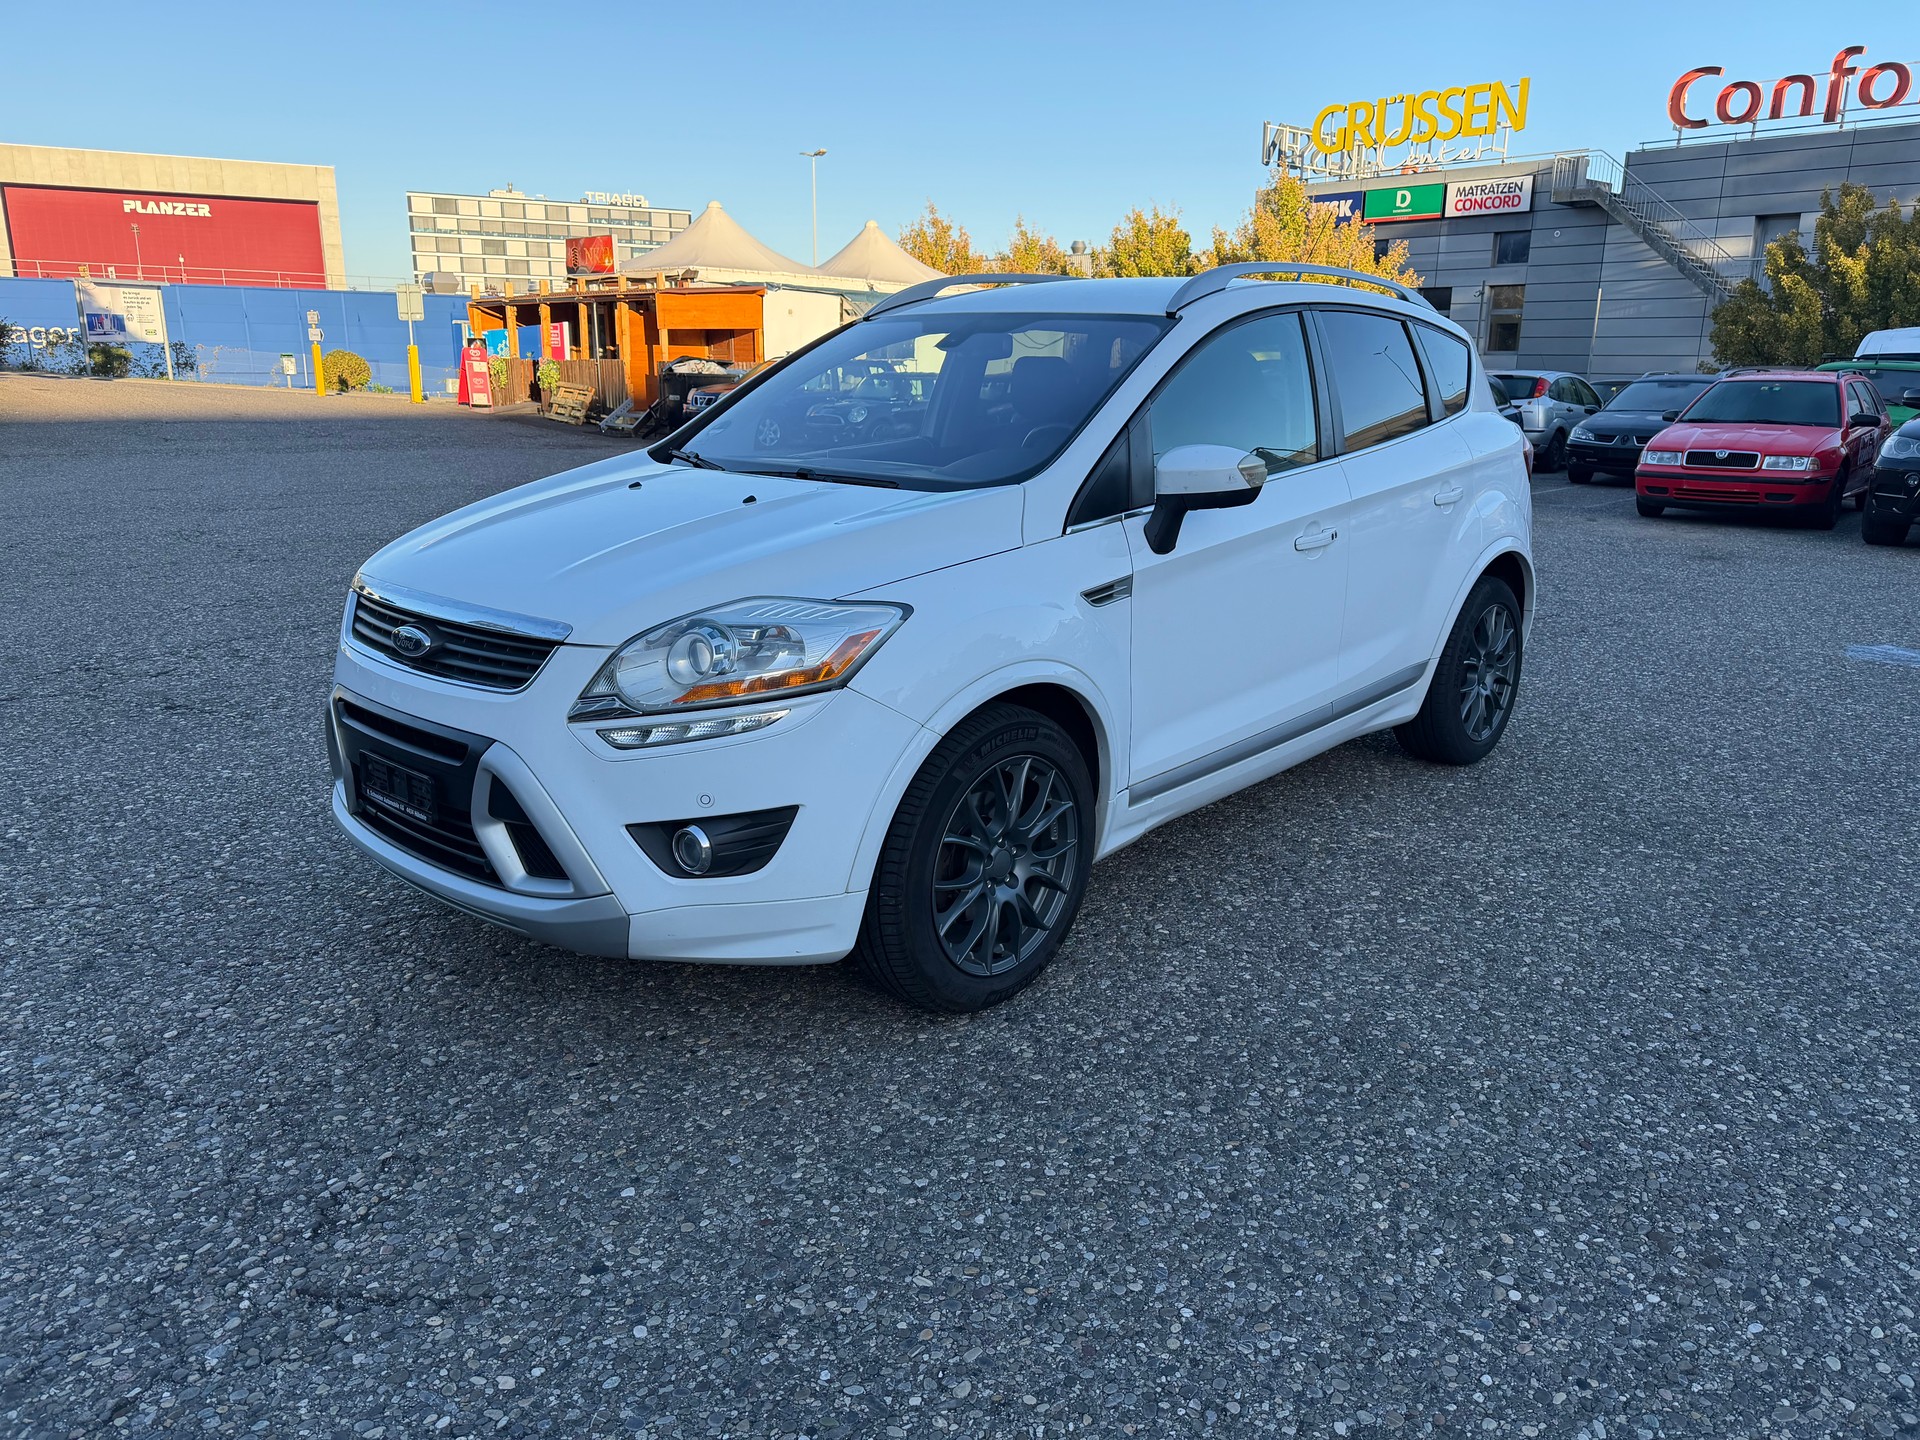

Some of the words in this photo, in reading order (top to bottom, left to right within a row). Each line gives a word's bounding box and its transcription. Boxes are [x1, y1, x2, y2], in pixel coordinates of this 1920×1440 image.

[1667, 45, 1912, 129] Confo
[1312, 77, 1530, 154] GRÜSSEN
[1380, 127, 1492, 171] Center
[1456, 181, 1523, 197] MATRATZEN
[585, 191, 645, 206] TRIAGO
[1396, 190, 1412, 208] D
[1454, 194, 1522, 212] CONCORD
[123, 199, 212, 217] PLANZER
[4, 326, 79, 349] ager
[397, 634, 416, 650] Ford
[980, 727, 1037, 756] MICHELIN
